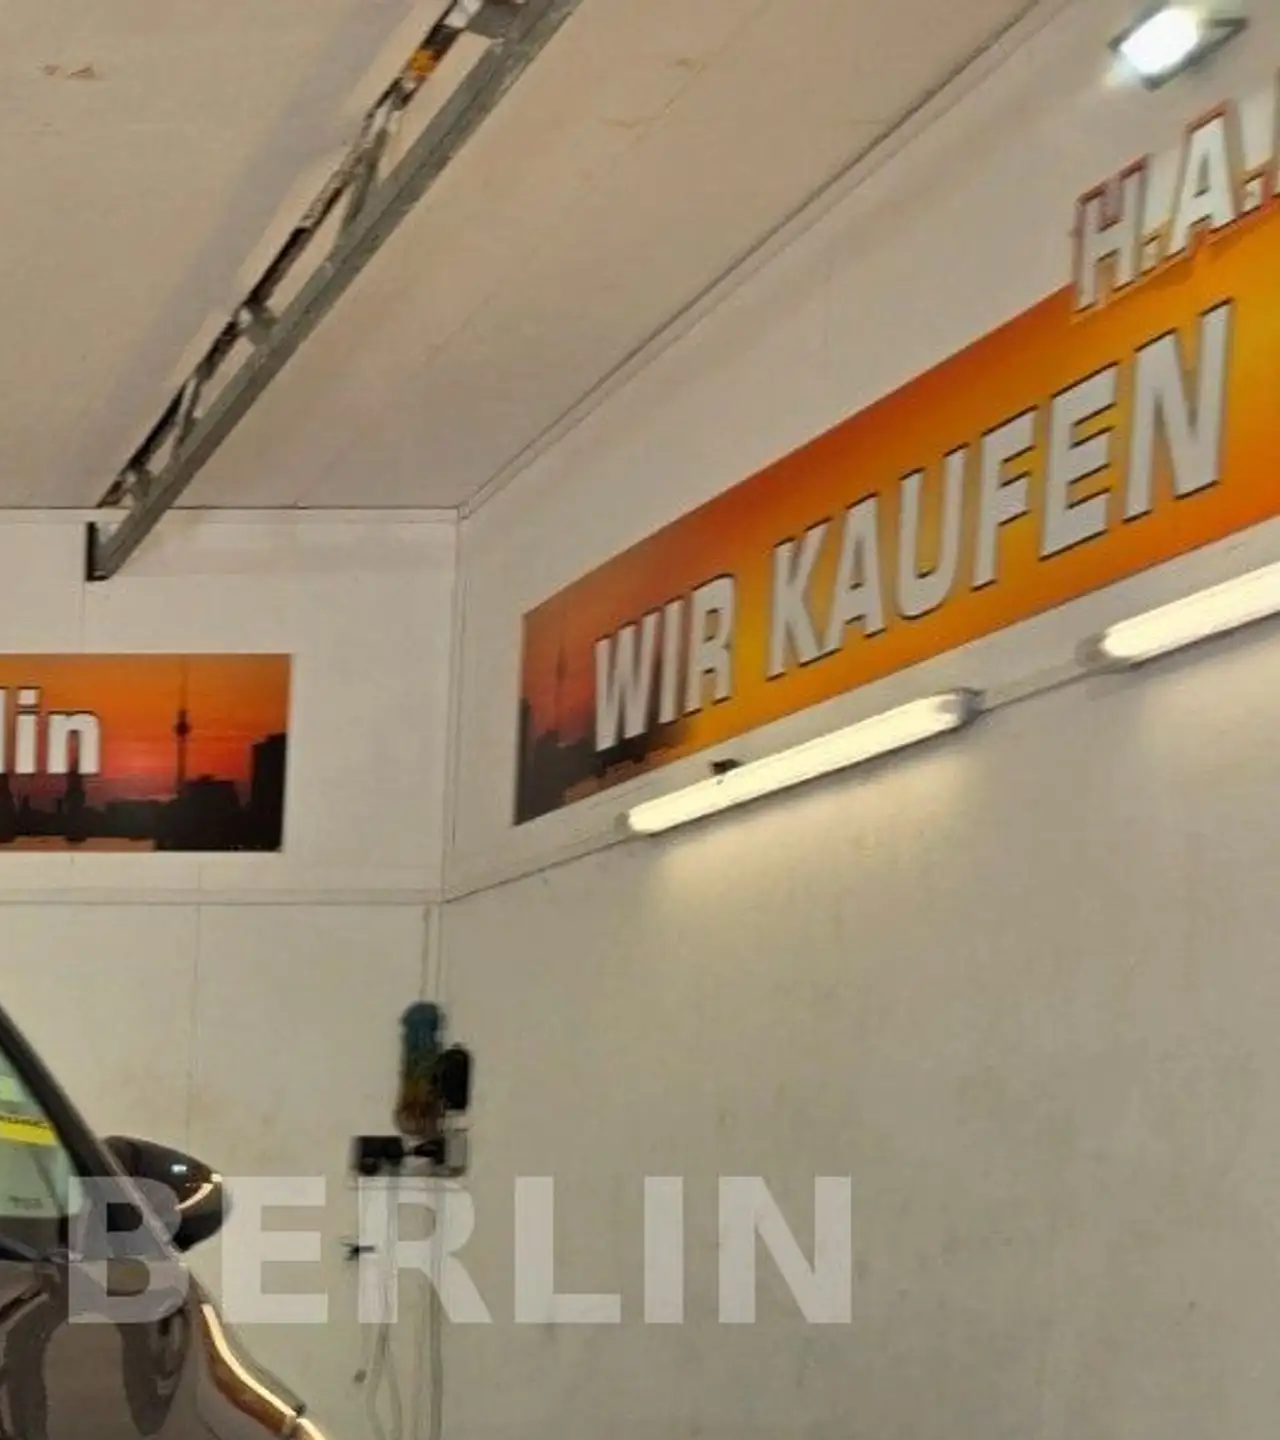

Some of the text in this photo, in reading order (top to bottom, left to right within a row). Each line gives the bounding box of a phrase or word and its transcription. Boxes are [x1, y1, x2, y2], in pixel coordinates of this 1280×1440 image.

[1072, 98, 1280, 315] H.A.
[594, 297, 1234, 752] WIR KAUFEN
